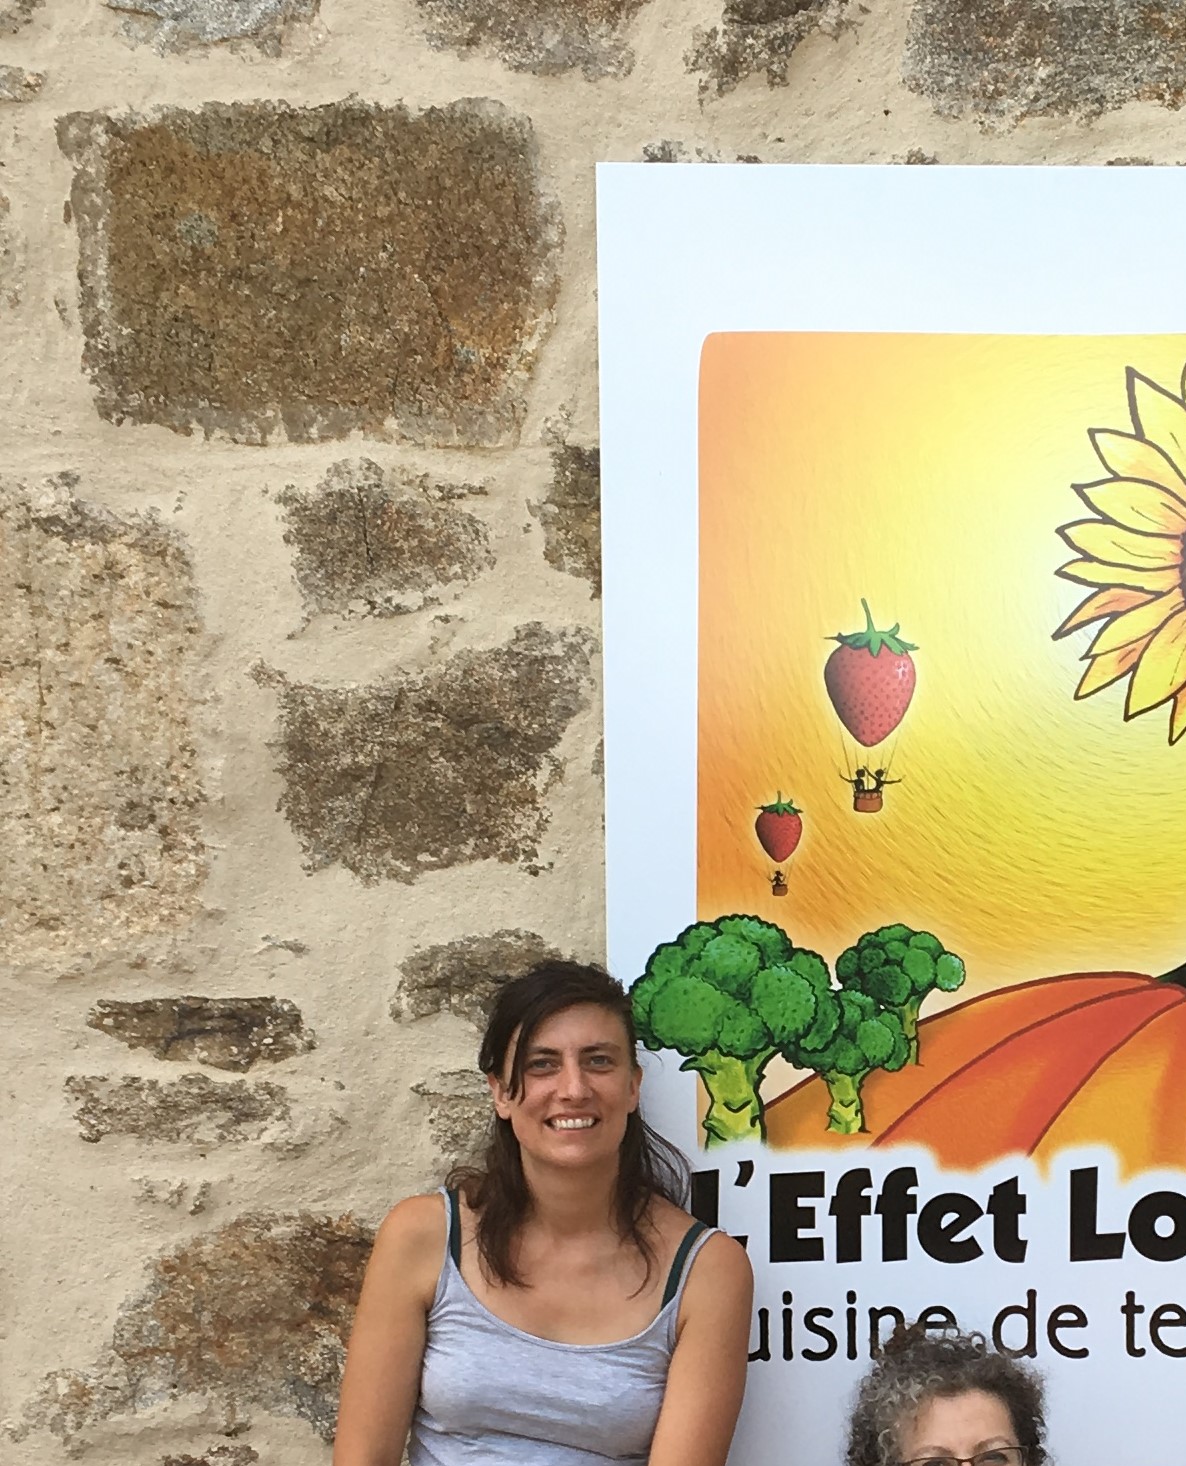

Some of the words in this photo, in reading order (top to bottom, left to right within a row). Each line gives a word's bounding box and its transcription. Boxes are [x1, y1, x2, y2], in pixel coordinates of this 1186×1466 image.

[690, 1159, 1028, 1265] L'Effet
[748, 1289, 957, 1362] uisine
[991, 1288, 1090, 1360] de
